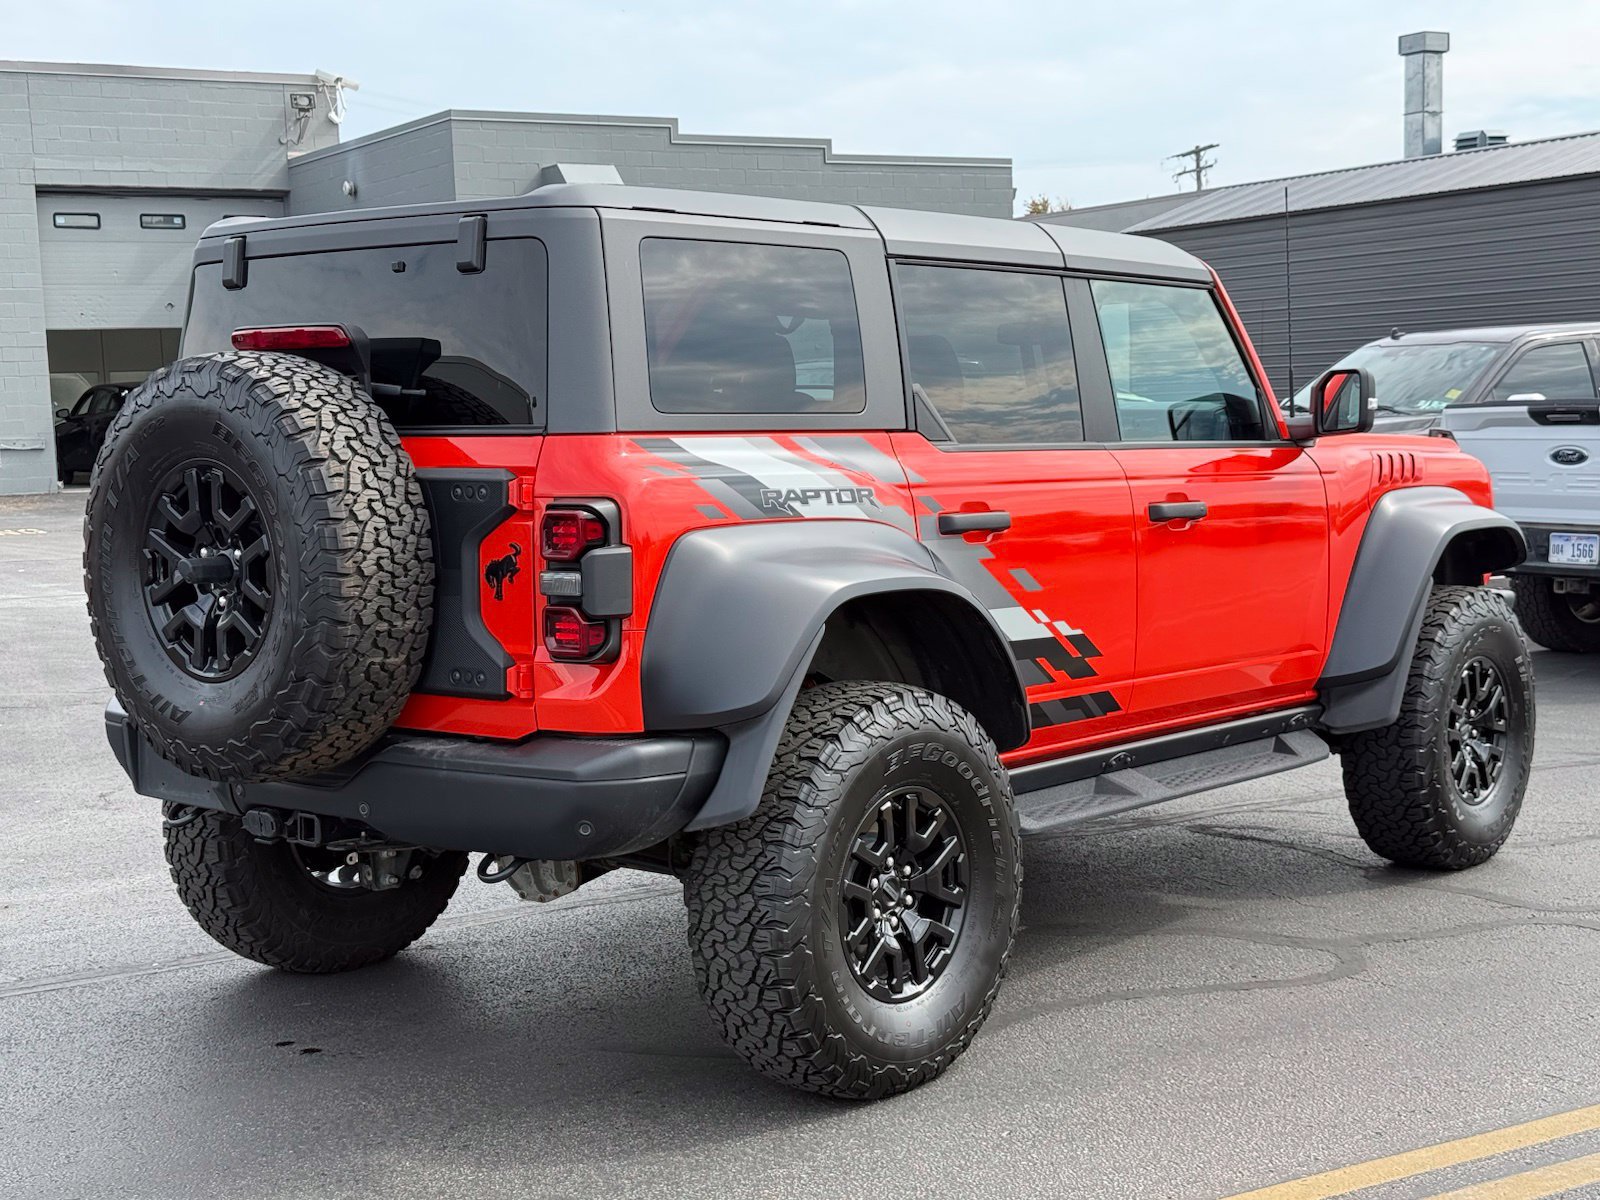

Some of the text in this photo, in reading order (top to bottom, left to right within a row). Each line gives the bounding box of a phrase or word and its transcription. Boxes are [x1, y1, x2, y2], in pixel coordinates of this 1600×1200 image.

[104, 443, 141, 508] T/A
[760, 487, 881, 515] RAPTOR
[1571, 543, 1594, 558] 1566
[884, 742, 1009, 885] BFGoodrich
[830, 970, 967, 1050] All-Terrain
